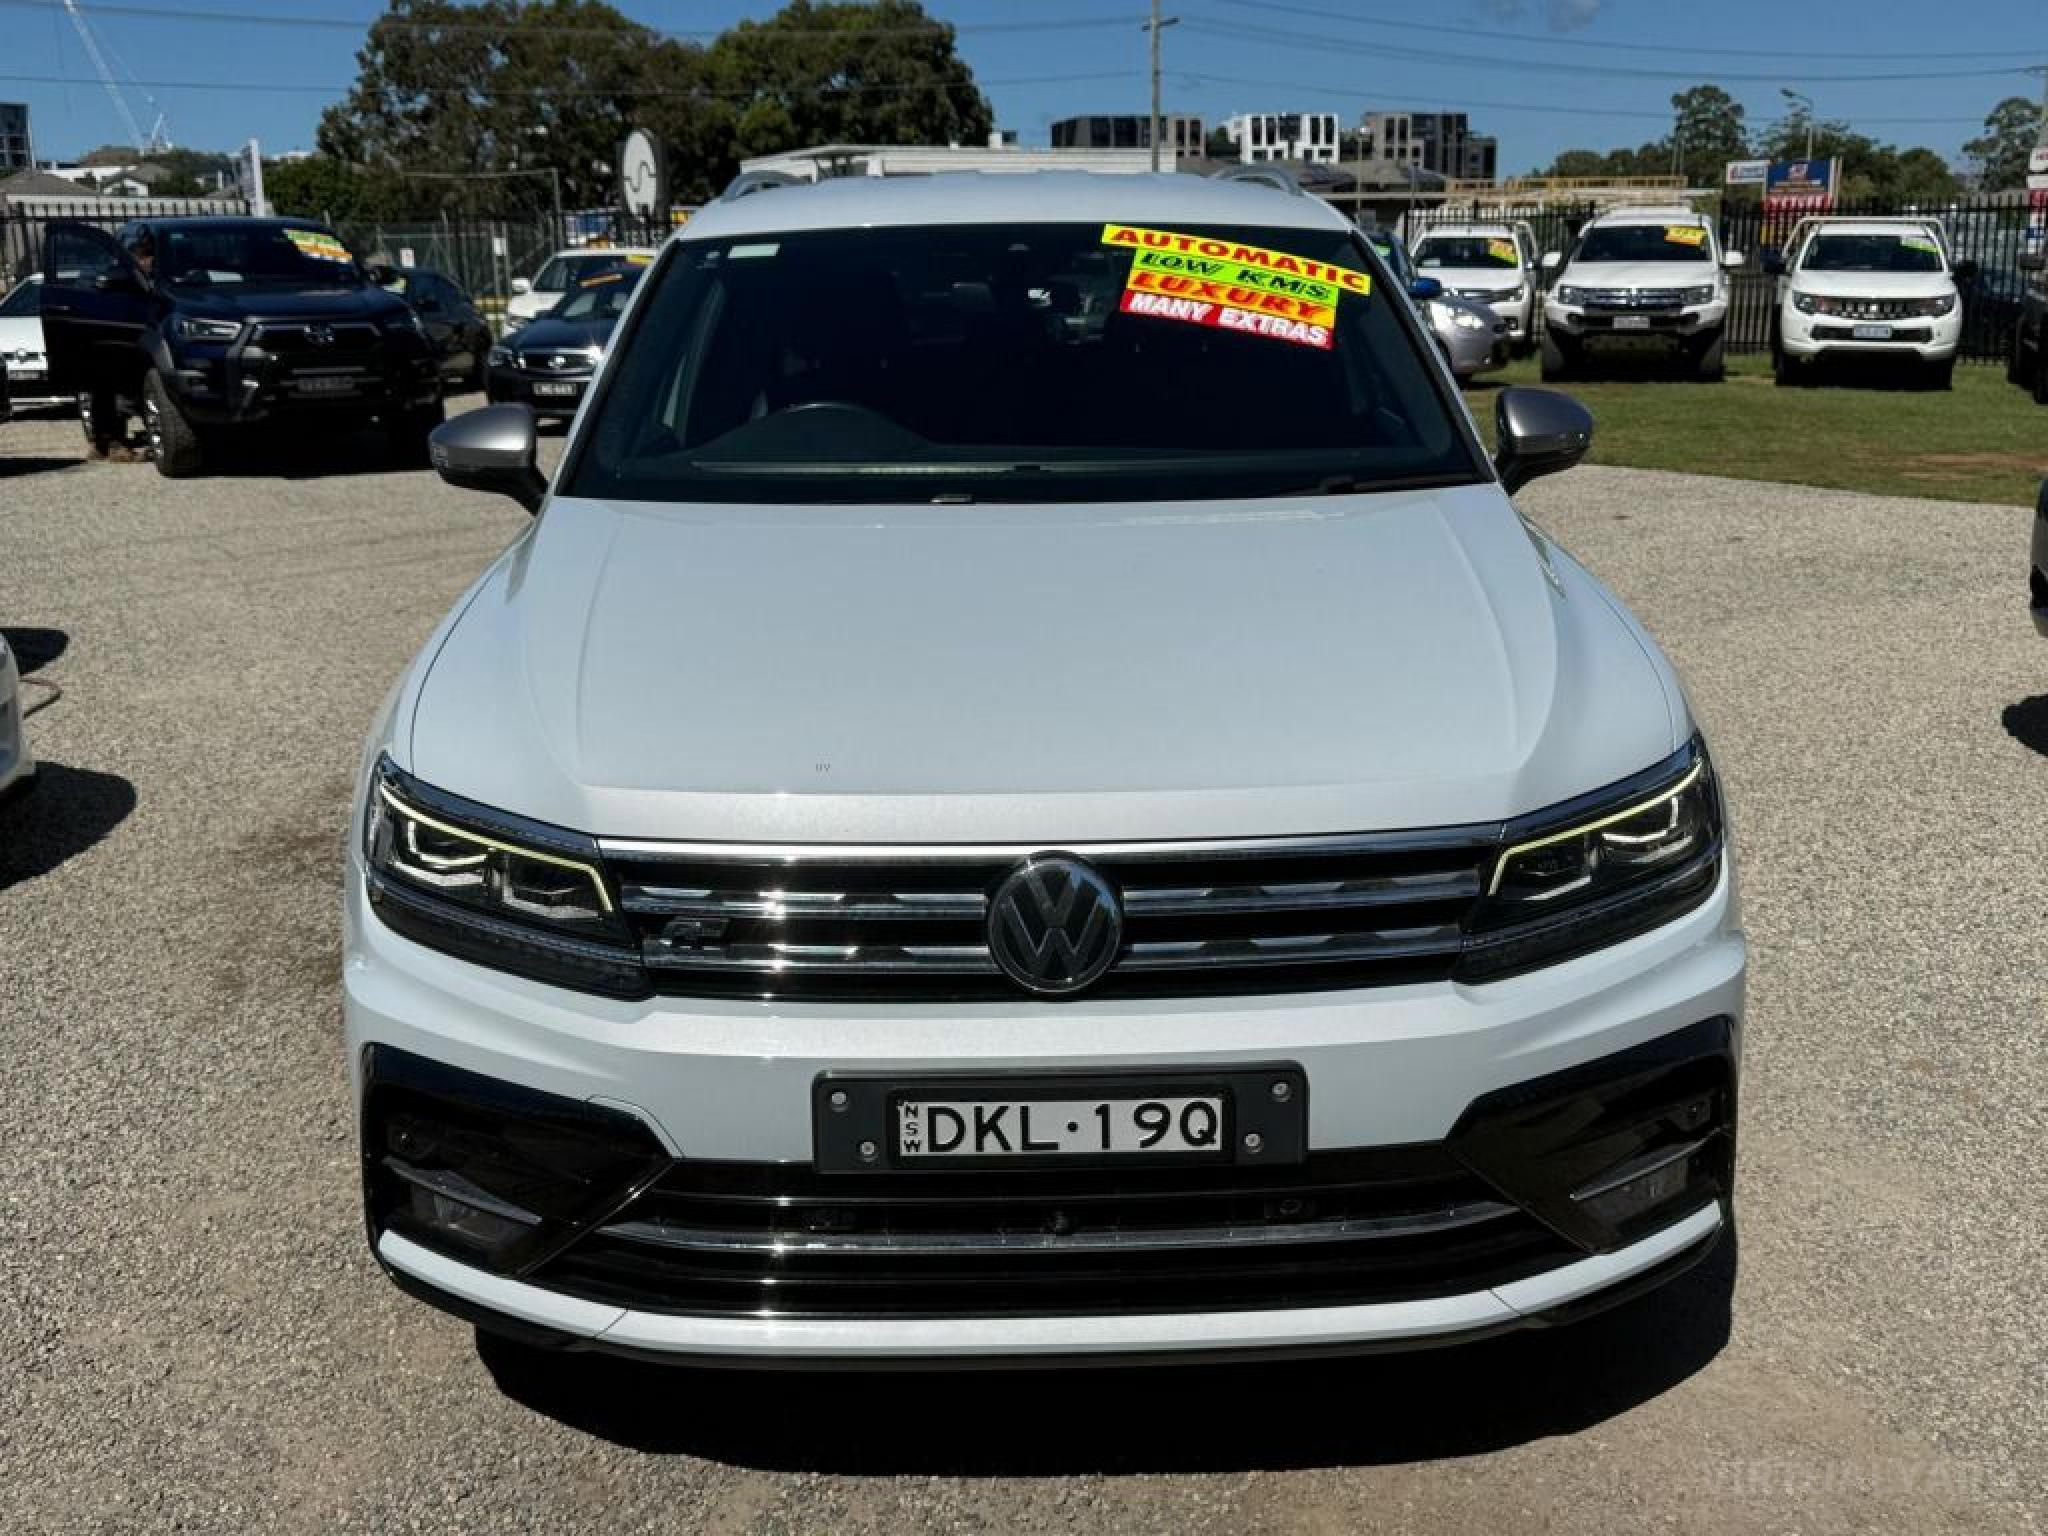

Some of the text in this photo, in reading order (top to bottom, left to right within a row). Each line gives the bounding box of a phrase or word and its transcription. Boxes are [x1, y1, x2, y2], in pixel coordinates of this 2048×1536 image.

[1110, 229, 1365, 289] AUTOMATIC
[1141, 252, 1330, 300] LOW KMS
[1128, 291, 1327, 346] MANY EXTRAS
[1132, 271, 1328, 318] LUXURY
[904, 1103, 921, 1153] NSW
